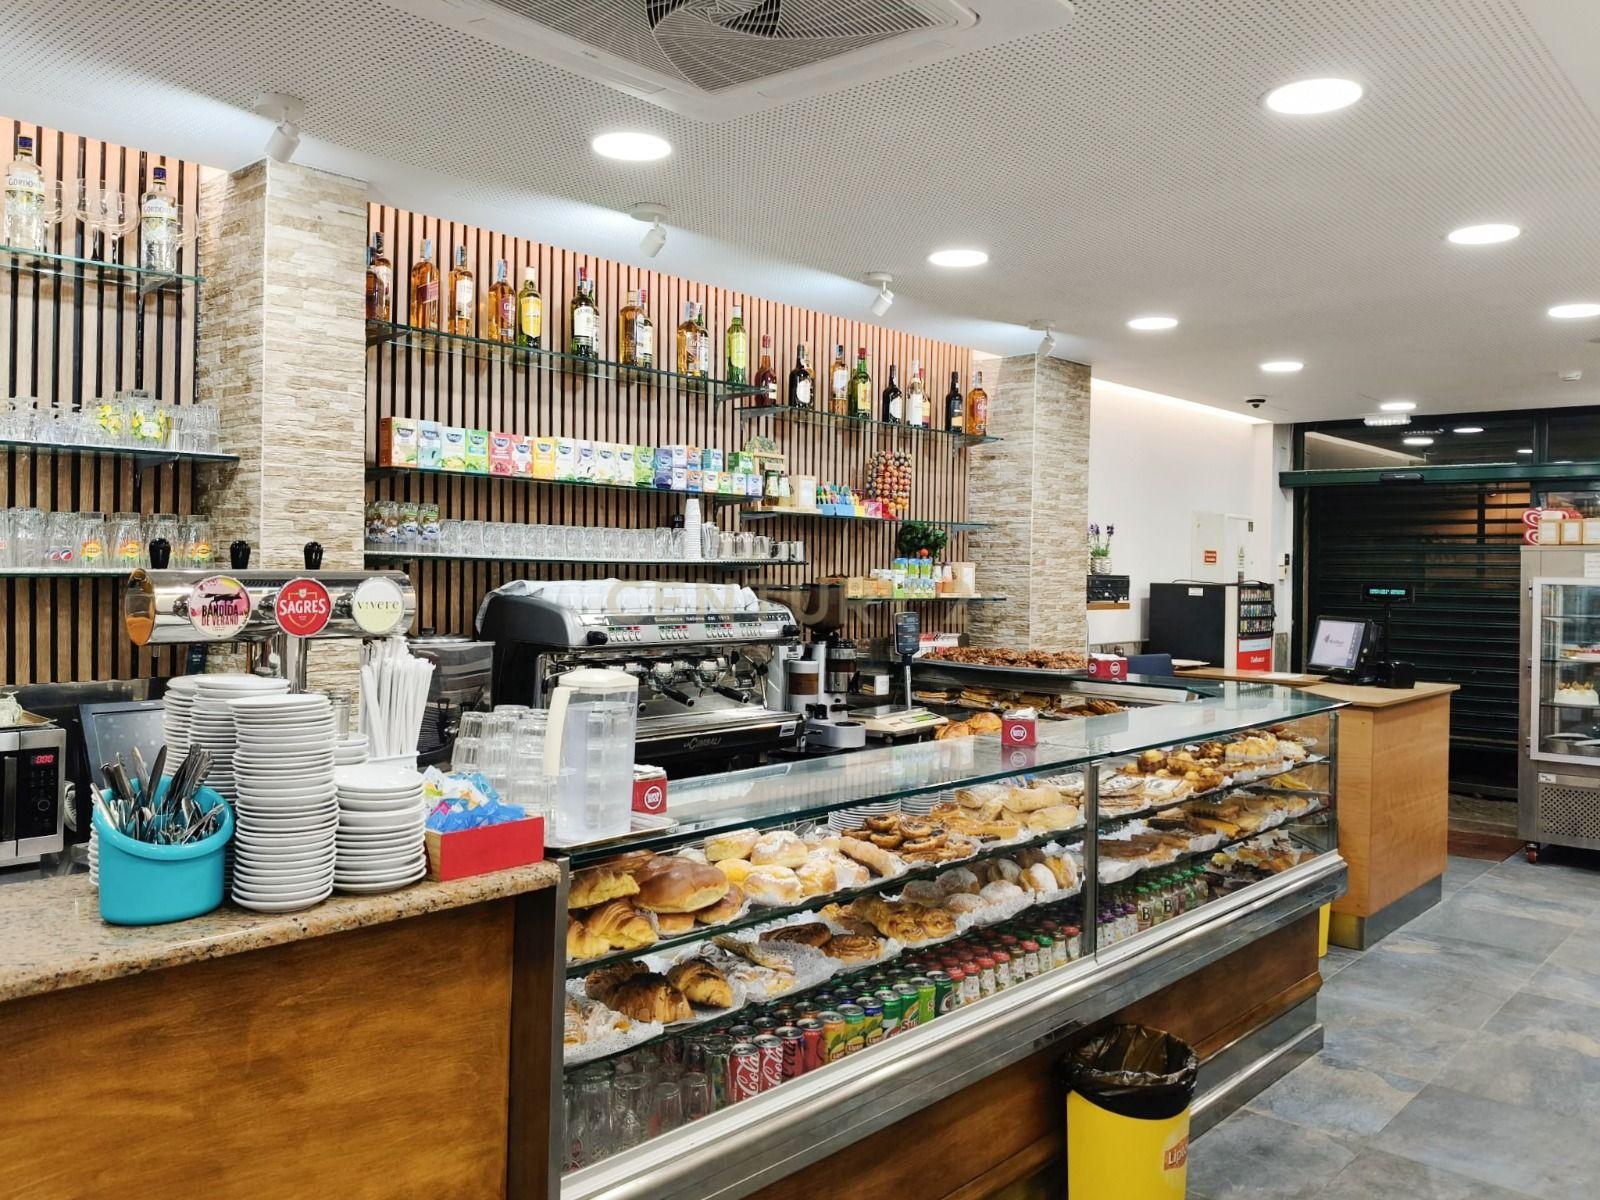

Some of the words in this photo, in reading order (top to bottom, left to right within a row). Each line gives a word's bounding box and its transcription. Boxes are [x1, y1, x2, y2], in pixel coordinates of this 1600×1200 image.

[202, 604, 238, 616] BANDIDA
[279, 598, 327, 616] SAGRES
[212, 615, 239, 626] VERANO
